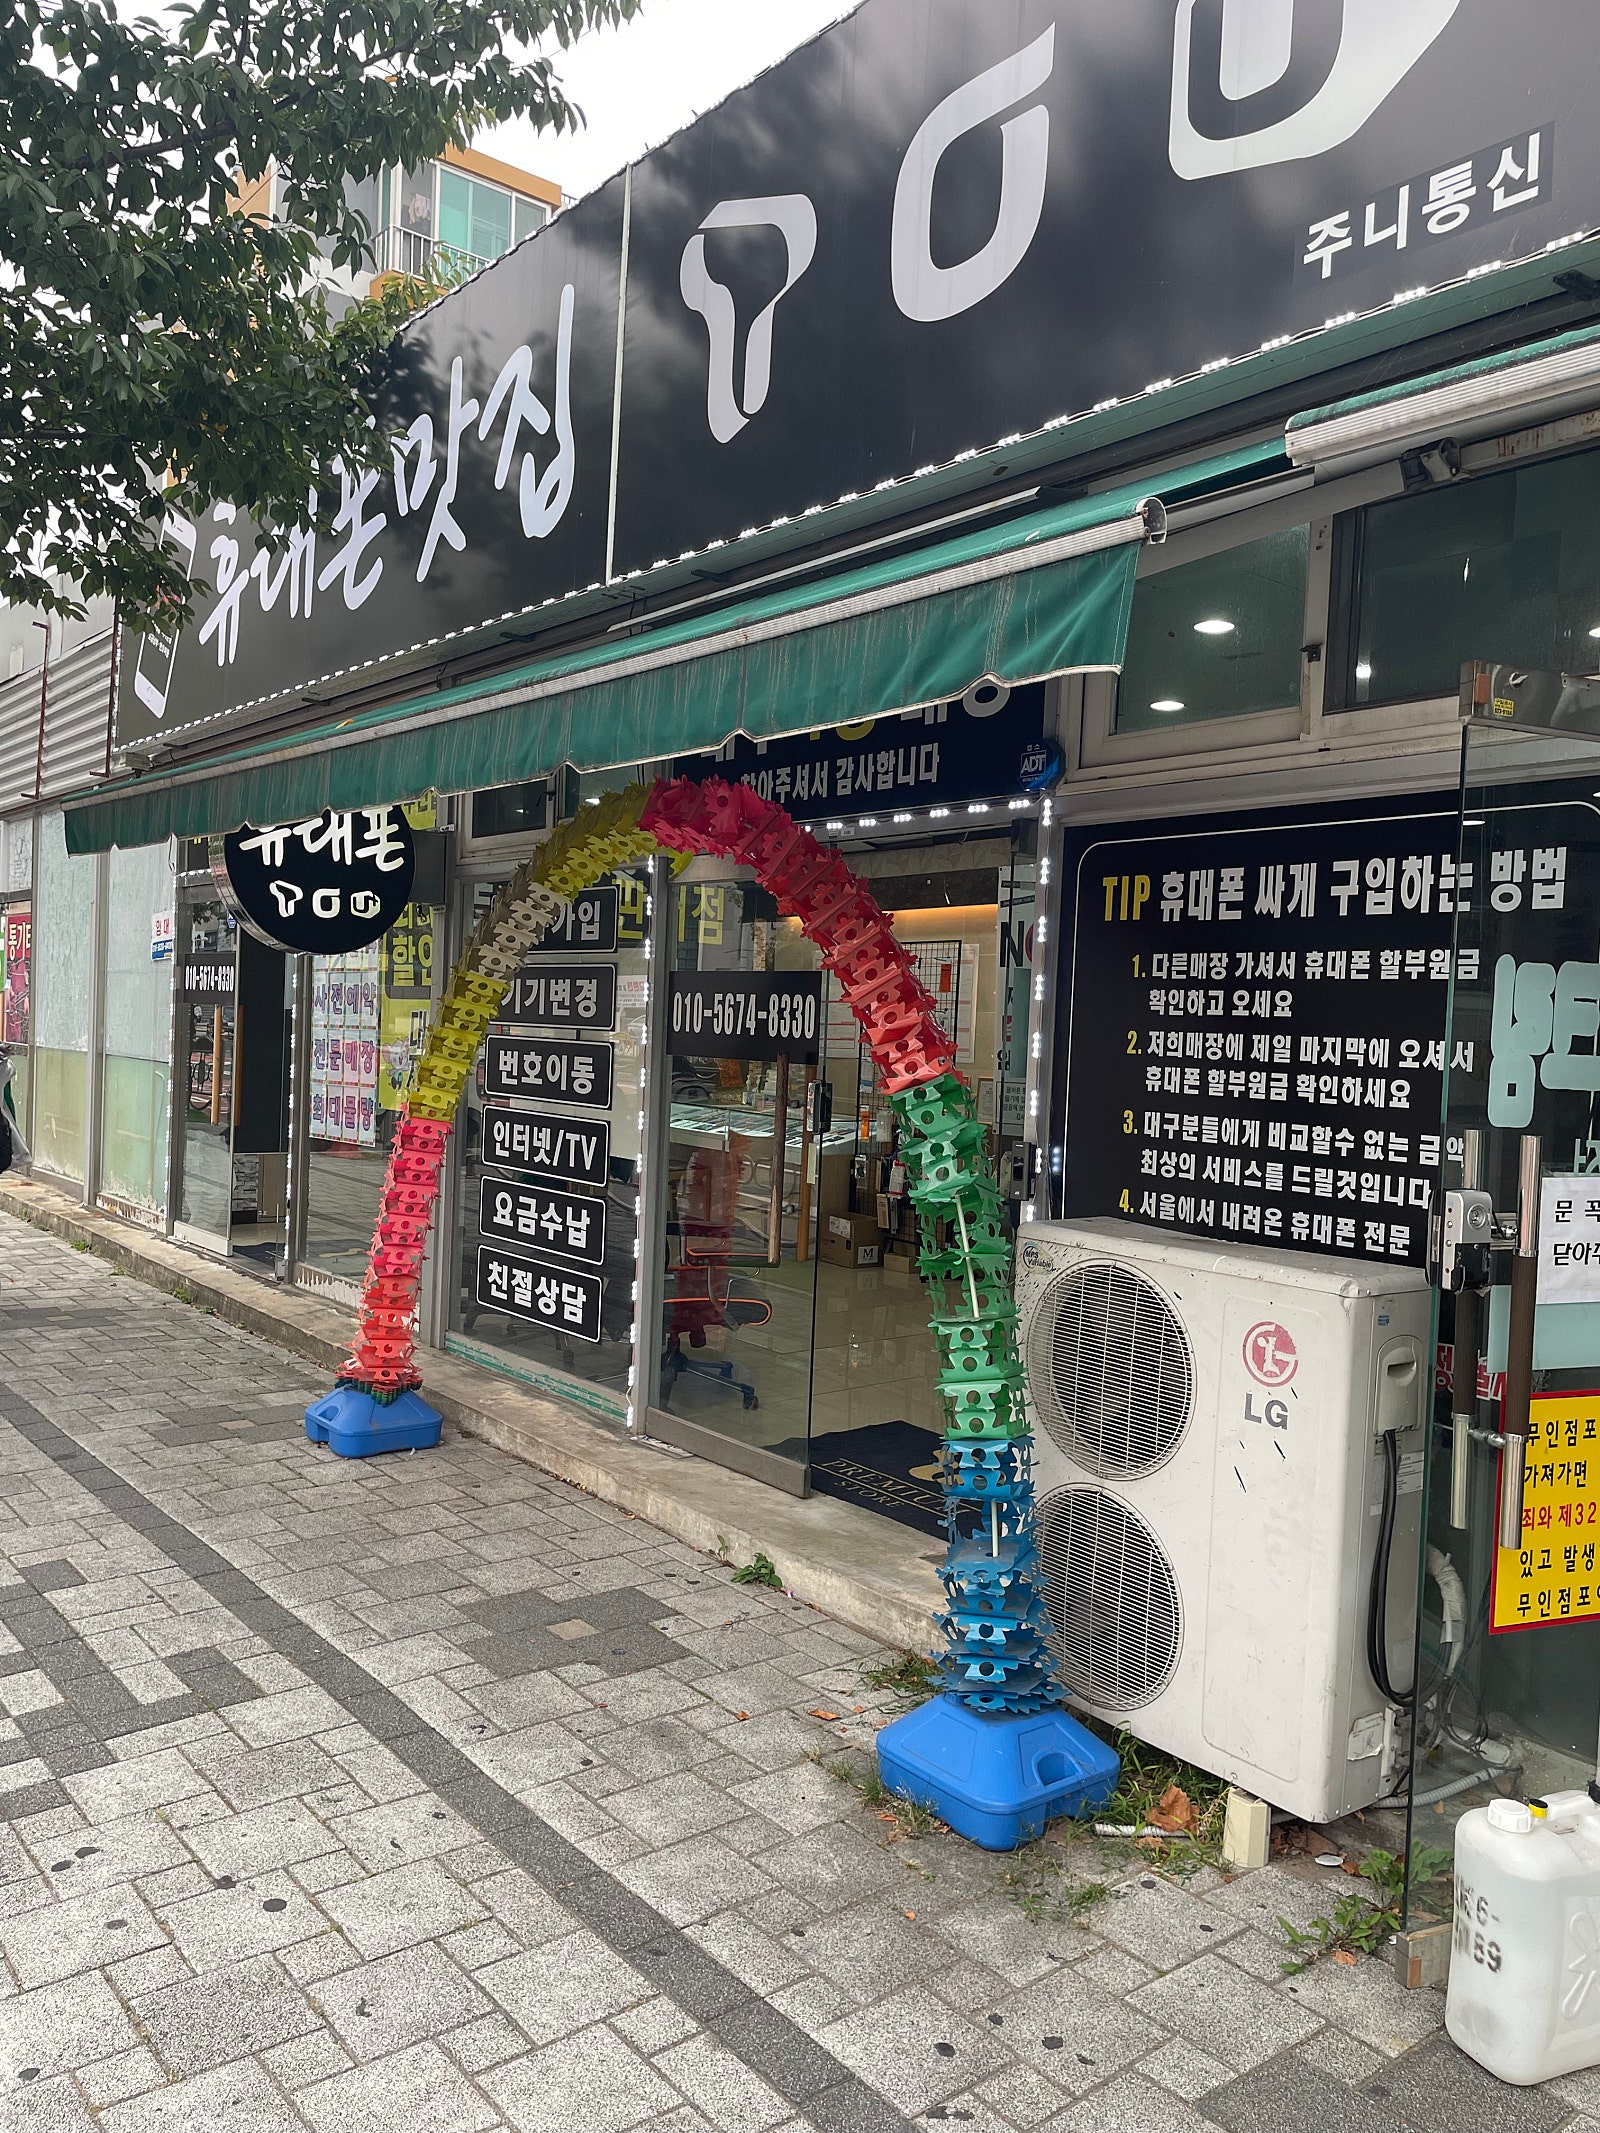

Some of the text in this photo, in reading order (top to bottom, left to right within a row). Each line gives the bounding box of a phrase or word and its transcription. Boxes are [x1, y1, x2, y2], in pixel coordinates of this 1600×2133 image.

[1303, 131, 1541, 280] 주니통신
[835, 742, 940, 797] 감사합니다
[1020, 754, 1047, 774] ADT
[1102, 874, 1151, 922] TIP
[1160, 866, 1245, 923] 휴대폰
[1254, 861, 1318, 919] 싸게
[1330, 853, 1474, 917] 구입하는
[1489, 846, 1568, 913] 방법
[541, 900, 600, 943] 가입
[185, 965, 235, 992] 010-5674-8330
[1131, 948, 1480, 980] 1. 다른매장 가셔서 휴대폰 할부원금
[314, 982, 376, 1016] 사전예약
[501, 977, 598, 1018] 기기변경
[672, 991, 816, 1040] 010-5674-8330
[1148, 989, 1293, 1018] 확인하고 오세요
[313, 1038, 375, 1075] 전문매장
[498, 1050, 596, 1096] 번호이동
[1126, 1030, 1475, 1073] 2. 저희매장에 제일 마지막에 오셔서
[1145, 1065, 1412, 1109] 휴대폰 할부원금 확인하세요
[312, 1093, 374, 1131] 최대물량
[493, 1120, 598, 1171] 인터넷/TV
[1121, 1109, 1138, 1135] 3.
[1143, 1111, 1261, 1149] 대구분들에게
[1267, 1121, 1356, 1157] 비교할수
[1363, 1128, 1409, 1164] 없는
[1140, 1148, 1432, 1210] 최상의 서비스를 드릴것입니다
[493, 1191, 591, 1249] 요금수납
[1118, 1188, 1411, 1257] 4. 서울에서 내려온 휴대폰 전문
[1554, 1200, 1573, 1223] 문
[487, 1260, 587, 1325] 친절상담
[1243, 1392, 1289, 1431] LG
[834, 1481, 906, 1508] STORE
[1524, 1459, 1588, 1489] 가져가면
[1519, 1548, 1552, 1579] 있고
